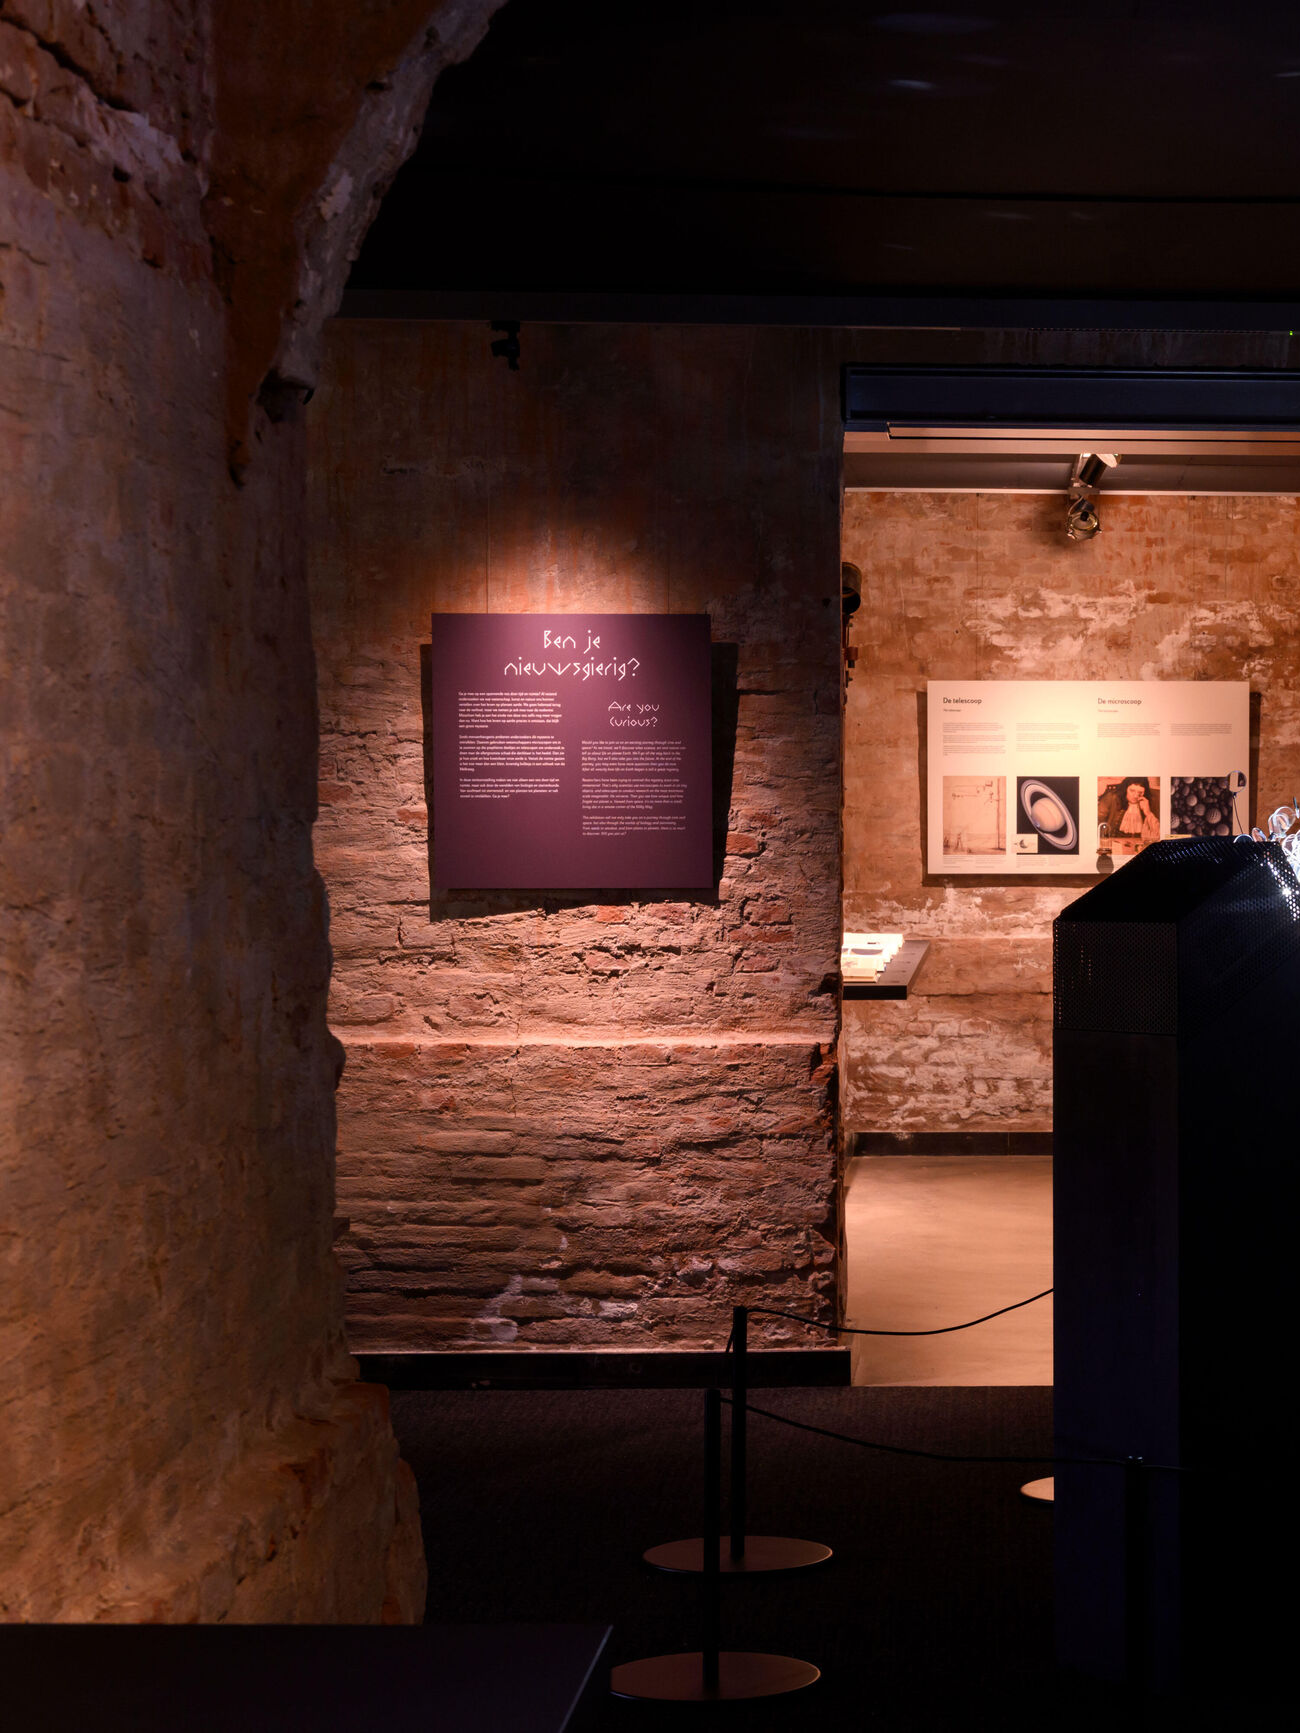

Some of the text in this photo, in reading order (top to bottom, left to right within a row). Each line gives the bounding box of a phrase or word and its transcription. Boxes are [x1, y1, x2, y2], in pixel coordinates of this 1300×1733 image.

[544, 629, 601, 655] Ben je
[504, 656, 640, 681] nieuwsgierig?
[608, 700, 660, 714] Are you
[953, 697, 982, 705] telescoop
[1097, 697, 1142, 706] De microscoop
[609, 715, 658, 728] Curious?
